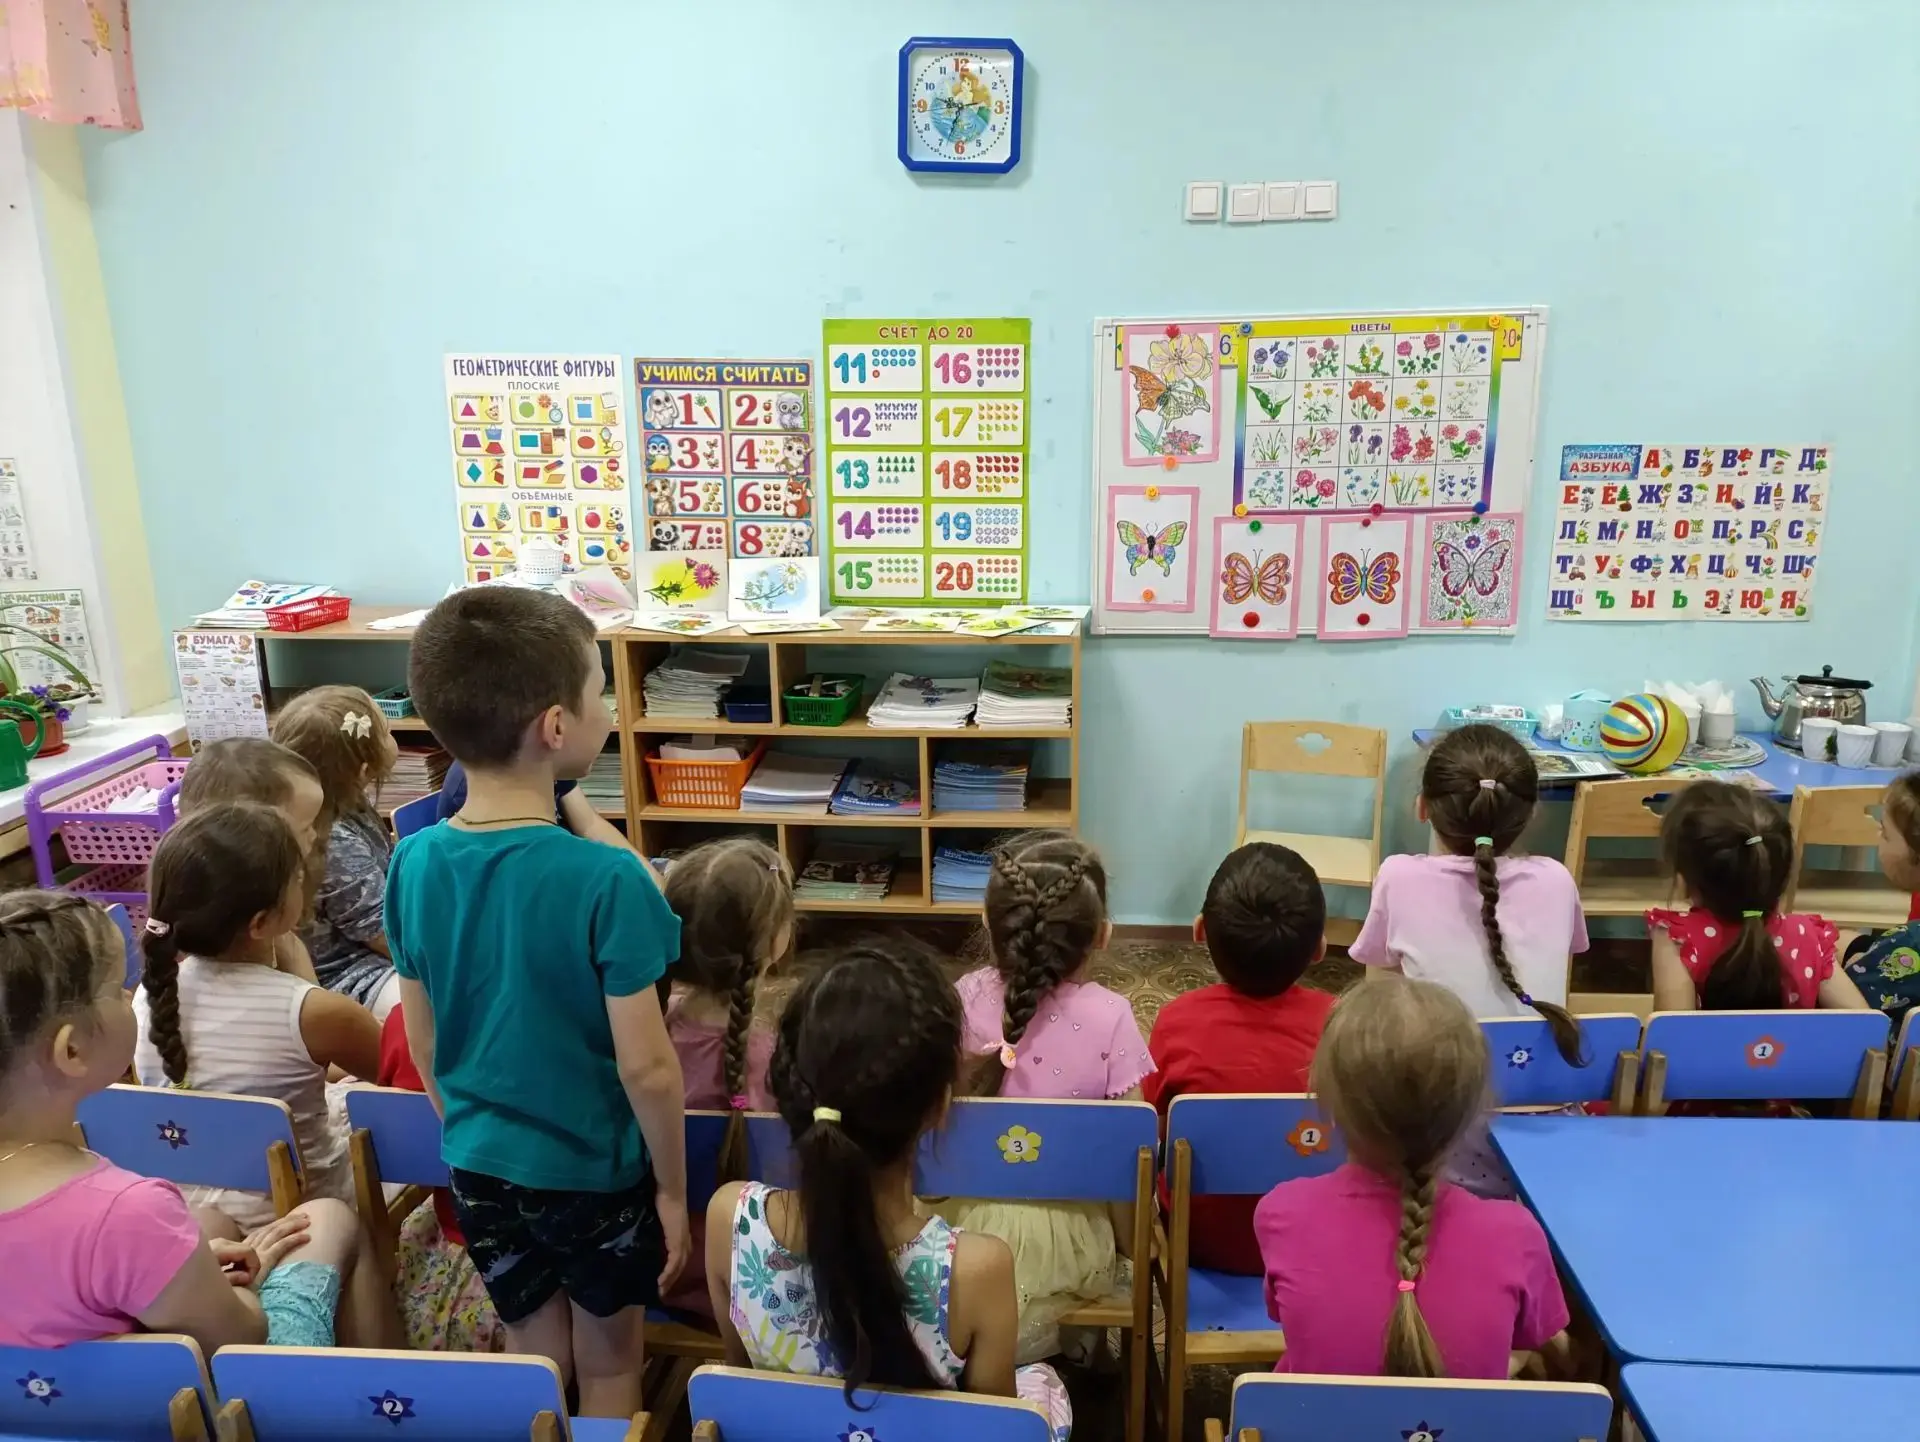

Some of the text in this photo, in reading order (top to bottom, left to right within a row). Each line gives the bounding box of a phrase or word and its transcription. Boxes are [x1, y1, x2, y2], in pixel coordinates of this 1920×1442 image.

[939, 66, 947, 75] 11
[953, 58, 970, 72] 12
[978, 66, 983, 74] 1
[925, 82, 935, 91] 10
[991, 82, 998, 90] 2
[917, 99, 928, 113] 9
[994, 100, 1005, 114] 3
[990, 124, 996, 132] 4
[938, 139, 944, 147] 7
[955, 140, 965, 155] 6
[976, 139, 982, 147] 5
[928, 327, 950, 340] ДО
[957, 327, 973, 338] 20
[1351, 323, 1391, 333] ЦВЕТЫ
[1220, 334, 1231, 356] 6
[453, 359, 615, 378] ГЕОМЕТРИЧЕСКИЕ ФИГУРЫ
[642, 365, 807, 383] УЧИМСЯ СЧИТАТЬ
[833, 352, 867, 384] 11
[934, 352, 972, 384] 16
[507, 381, 561, 391] ПЛОСКИЕ
[677, 393, 698, 425] 1
[735, 394, 759, 426] 2
[835, 407, 871, 438] 12
[934, 407, 973, 438] 17
[677, 437, 700, 469] 3
[735, 438, 760, 470] 4
[1579, 452, 1624, 460] РАЗРЕЗНАЯ
[1644, 448, 1817, 471] А Б В Г Д
[836, 459, 870, 489] 13
[934, 459, 972, 489] 18
[1569, 461, 1632, 473] АЗБУКА
[511, 490, 574, 501] ОБЪЁМНЫЕ
[678, 480, 700, 512] 5
[738, 481, 762, 513] 6
[1563, 481, 1811, 505] Е Ё Ж З И Й К
[837, 510, 875, 540] 14
[935, 511, 972, 541] 19
[1559, 519, 1804, 540] Л М Н О П Р С
[681, 524, 702, 550] 7
[739, 524, 763, 555] 8
[1556, 554, 1806, 576] Т У Ф Х Ц Ч Ш
[837, 560, 874, 590] 15
[935, 561, 973, 591] 20
[1550, 589, 1798, 610] Щ Ъ Ы Ь Э Ю Я
[193, 635, 236, 645] БУМАГА
[1516, 1052, 1524, 1060] 2
[1758, 1045, 1767, 1057] 1
[166, 1127, 177, 1139] 2
[1305, 1130, 1315, 1143] 1
[1013, 1140, 1023, 1152] 3
[35, 1380, 45, 1391] 2
[385, 1399, 401, 1414] 2
